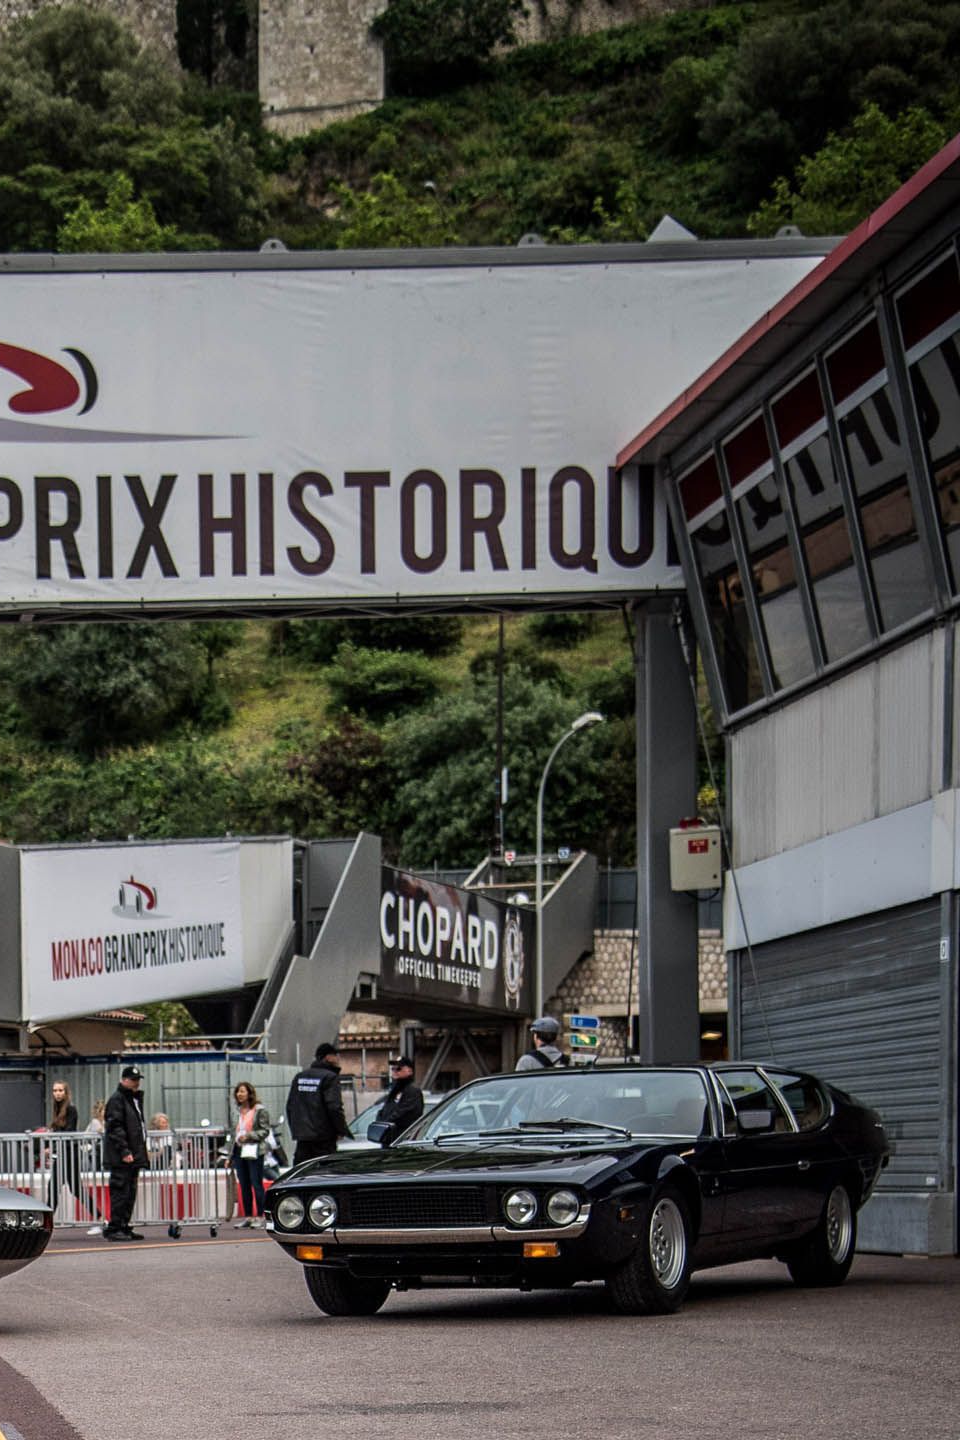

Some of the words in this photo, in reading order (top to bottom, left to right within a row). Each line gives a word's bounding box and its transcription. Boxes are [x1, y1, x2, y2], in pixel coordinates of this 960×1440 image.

[51, 936, 104, 981] MONACO
[104, 932, 143, 974] GRAND
[143, 929, 169, 967] PRIX
[168, 922, 226, 964] HISTORIQUE
[380, 891, 499, 970] CHOPARD
[398, 955, 436, 980] OFFICIAL
[436, 964, 482, 989] TIMEKEEPER
